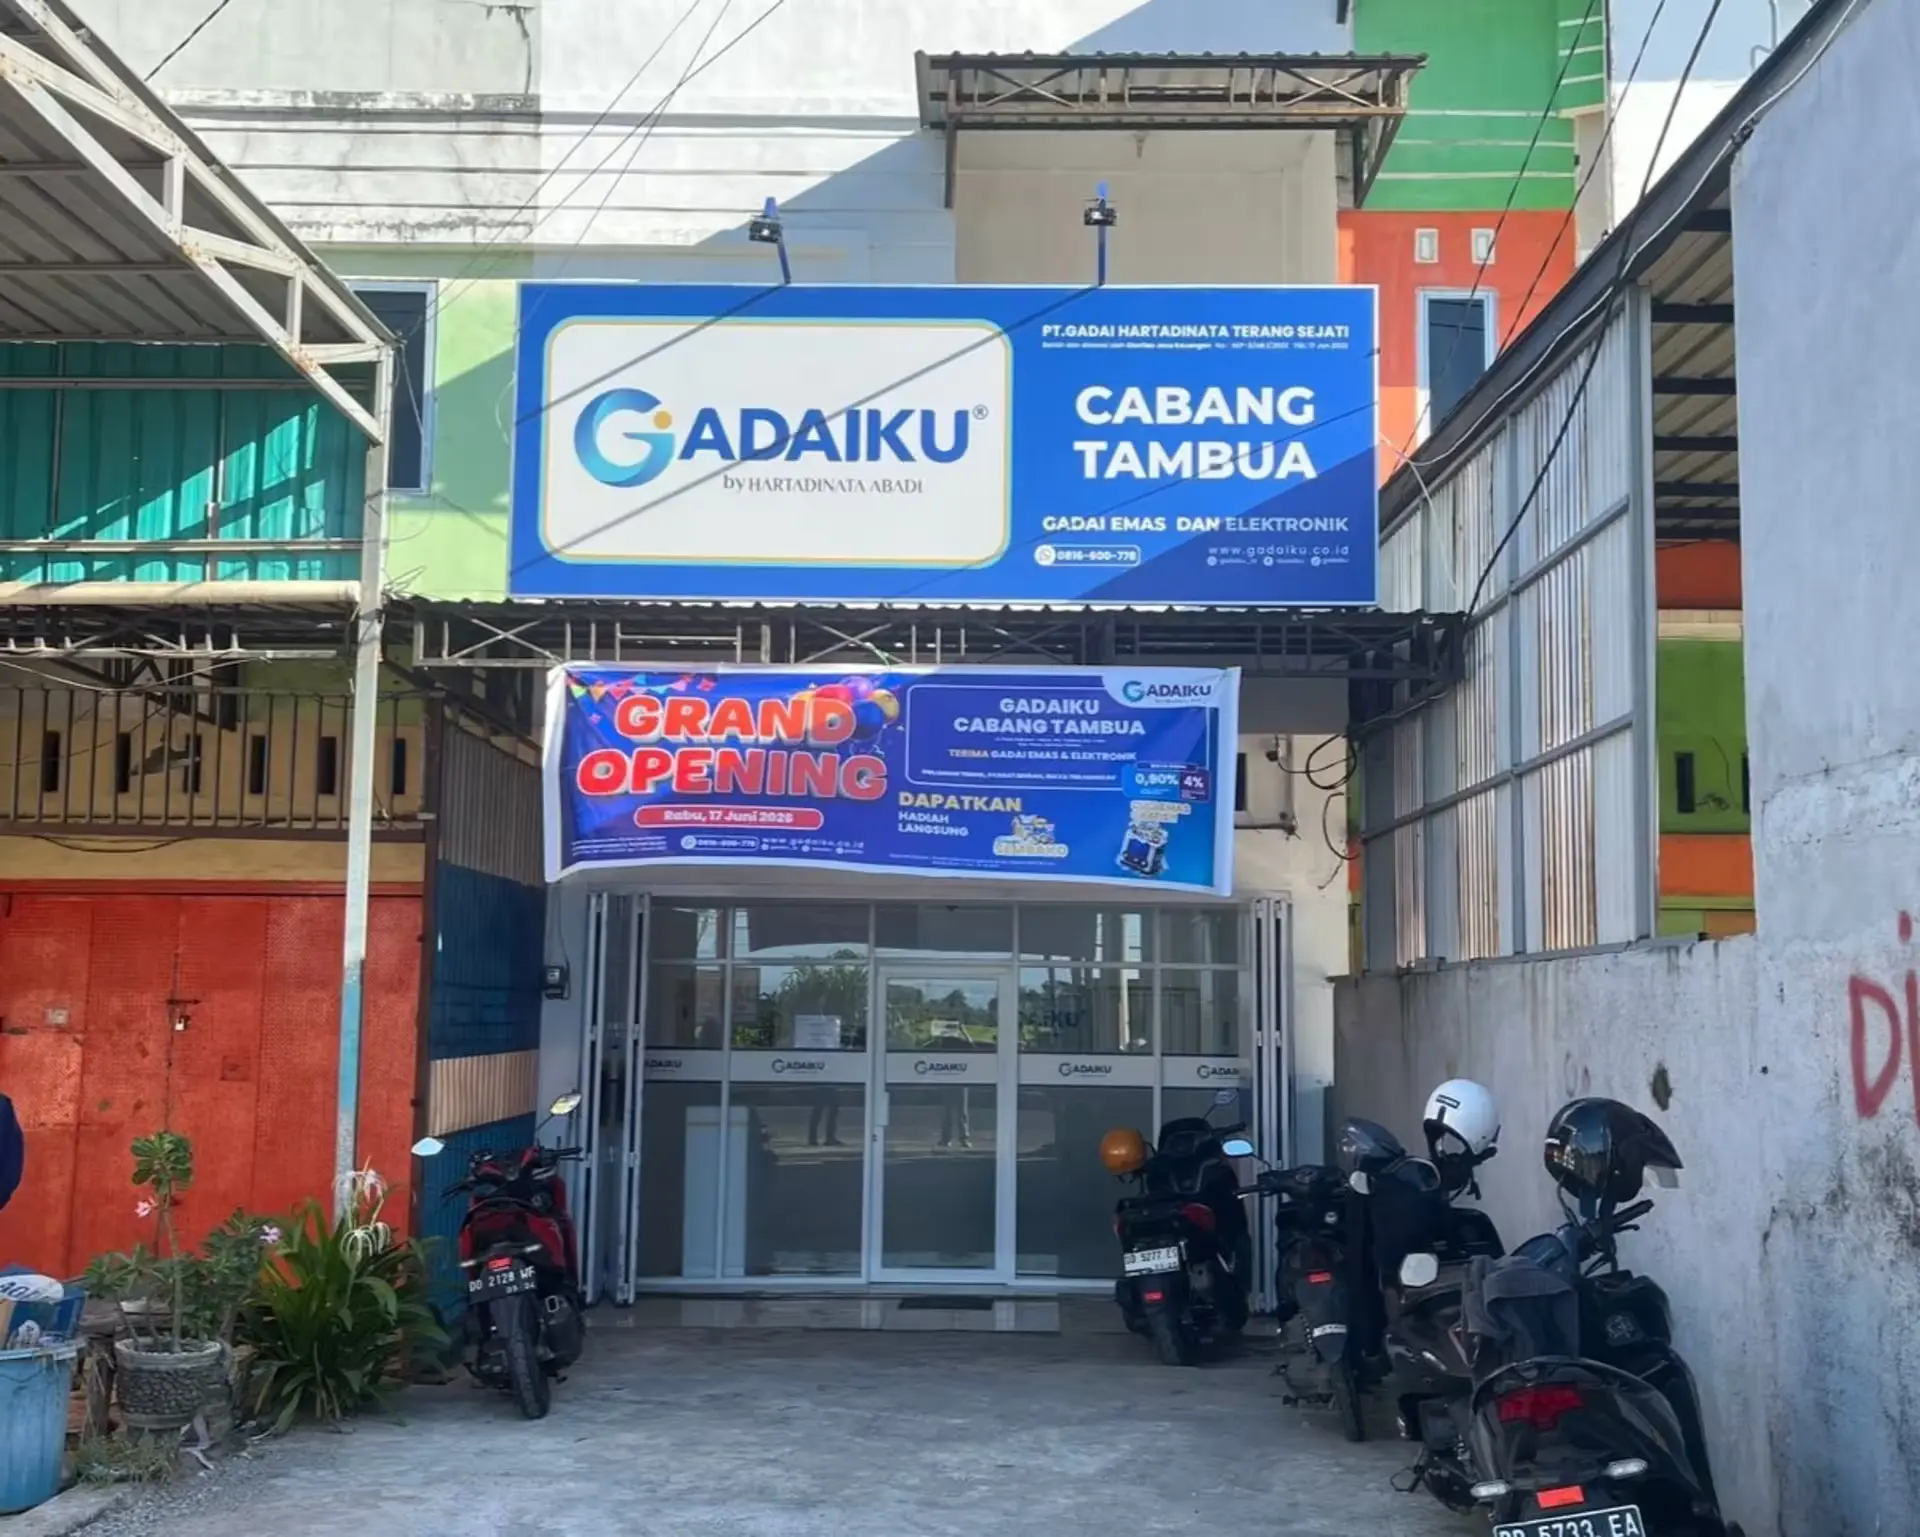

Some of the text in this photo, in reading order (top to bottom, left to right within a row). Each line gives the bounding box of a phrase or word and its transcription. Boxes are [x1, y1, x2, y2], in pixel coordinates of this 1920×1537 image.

[1041, 324, 1350, 338] PT.GADAI HARTADINATA TERANG SEJATI
[1075, 385, 1315, 426] CABANG
[573, 387, 970, 489] GADAIKU
[1073, 441, 1318, 481] TAMBUA
[723, 473, 923, 495] by HARTADINATA ABADI
[1042, 516, 1349, 532] GADAI EMAS DAN ELEKTRONIK
[1208, 544, 1350, 558] www.gadaiku.co.id
[1122, 680, 1212, 703] GADAIKU
[1000, 698, 1100, 714] GADAIKU
[615, 694, 857, 744] GRAND
[953, 717, 1146, 736] CABANG TAMBUA
[990, 750, 1027, 759] GADAI
[1028, 750, 1059, 759] EMAS
[1071, 751, 1137, 761] ELEKTRONIK
[576, 747, 888, 801] OPENING
[898, 791, 1022, 812] DAPATKAN
[663, 810, 707, 822] Rabu,
[708, 810, 723, 821] 17
[724, 810, 758, 822] Juni
[898, 811, 949, 823] HADIAH
[898, 823, 969, 837] LANGSUNG
[643, 1059, 683, 1070] ADAIKU
[771, 1058, 826, 1074] GADAIKU
[914, 1060, 968, 1075] GADAIKU
[1058, 1062, 1112, 1077] GADAIKU
[1608, 1512, 1640, 1537] EA
